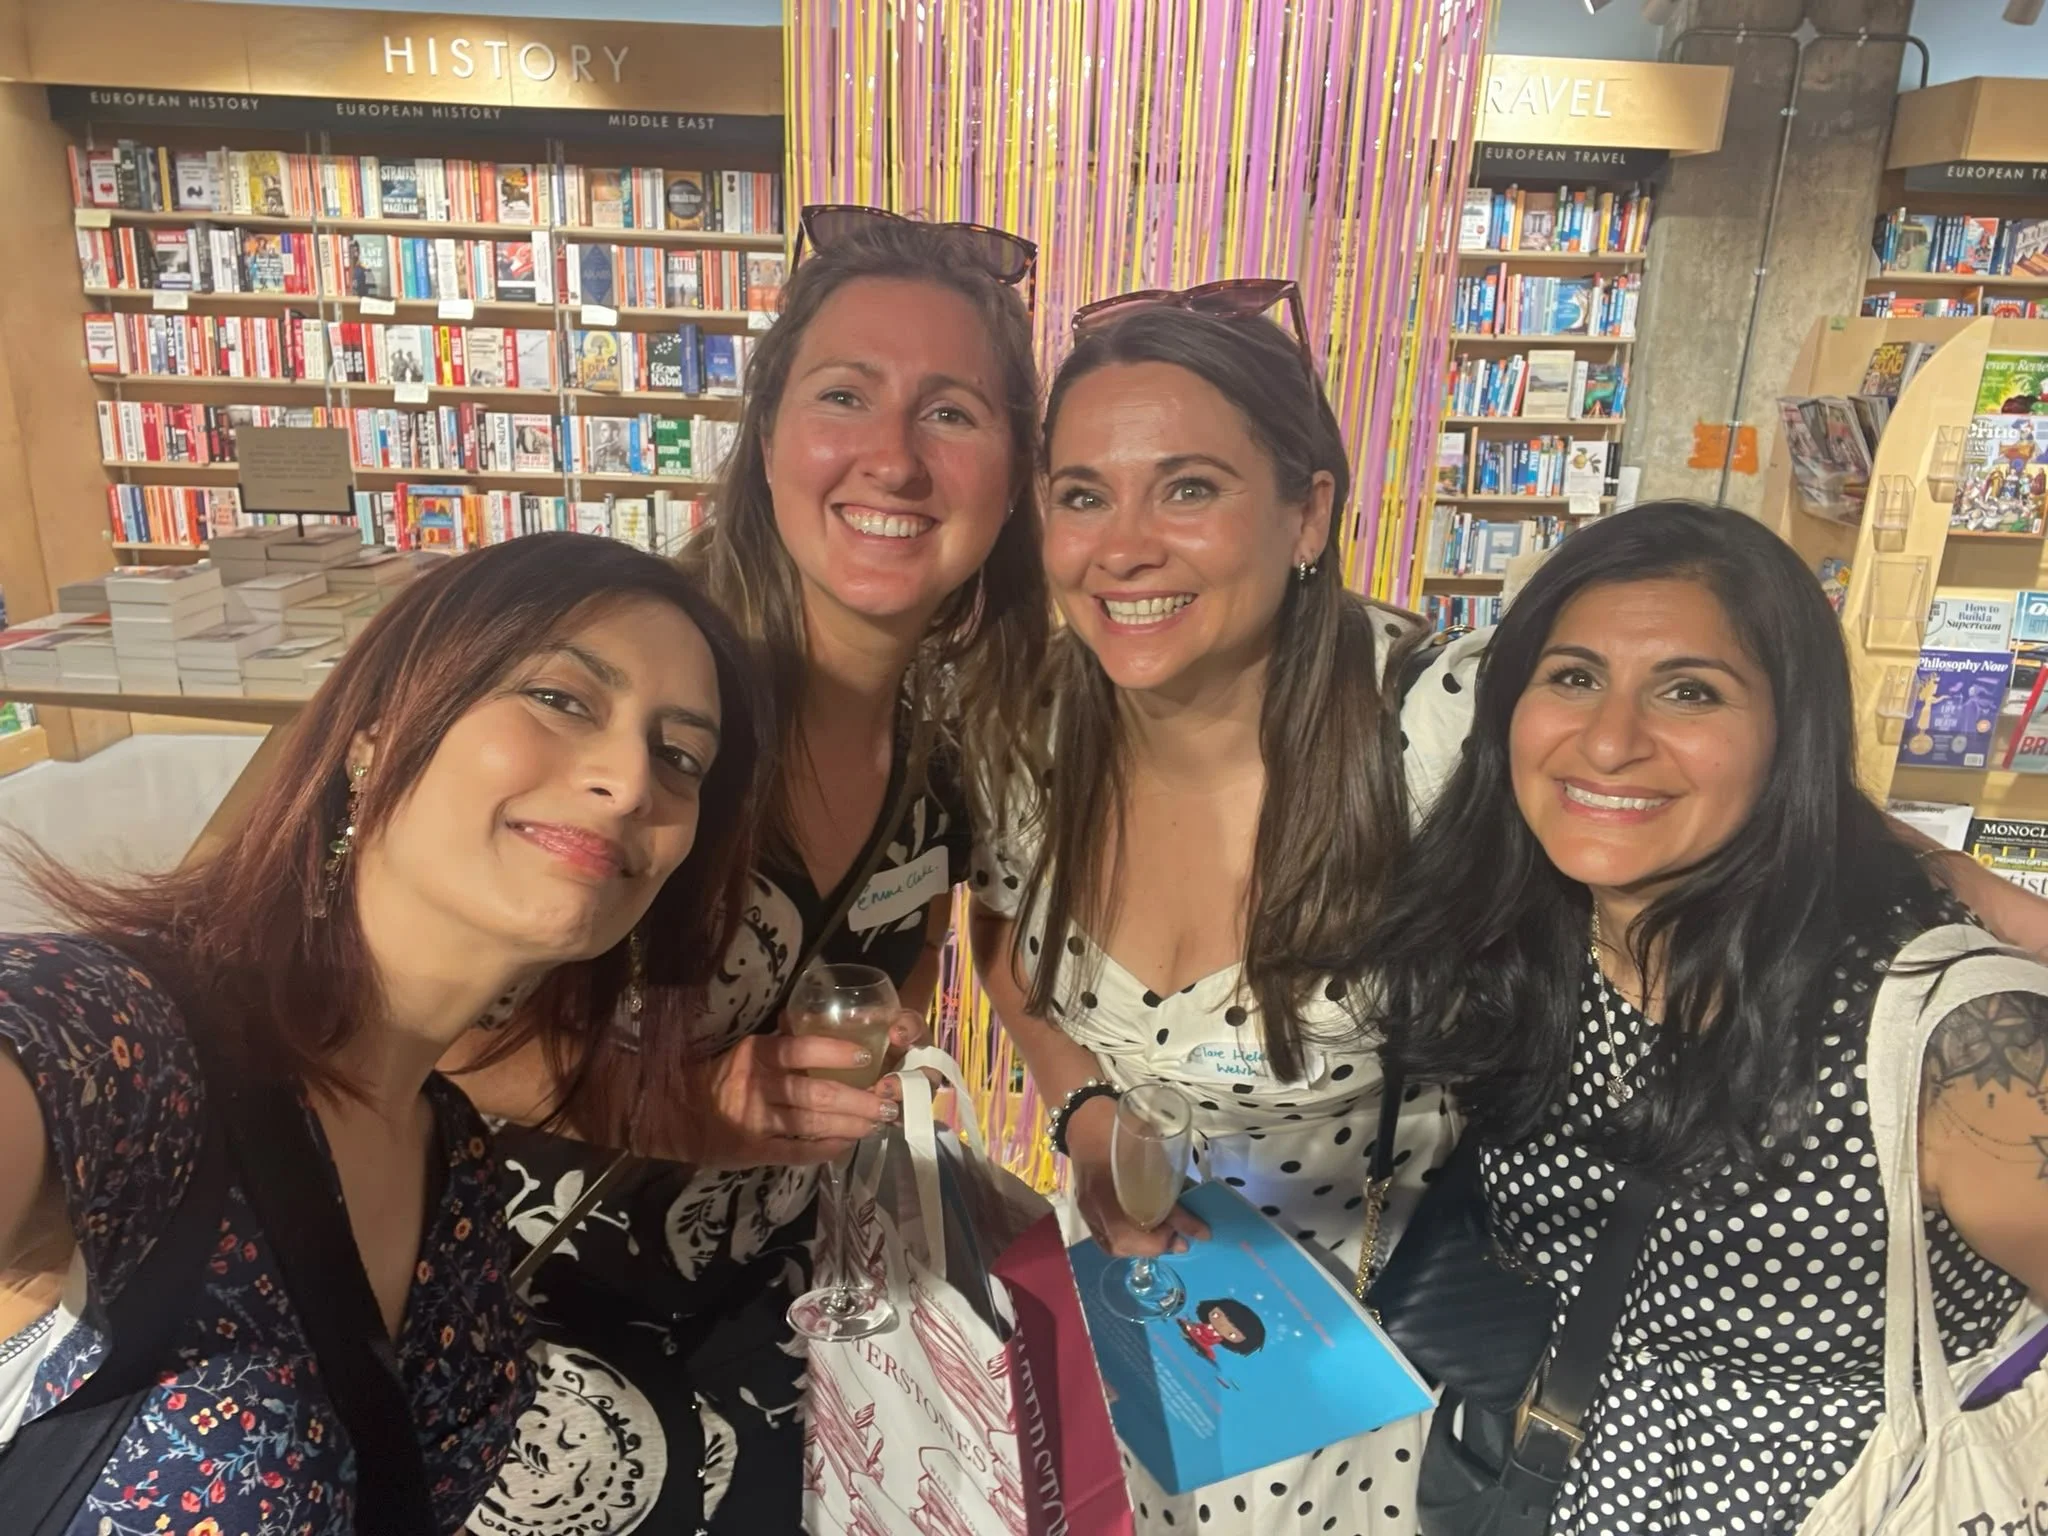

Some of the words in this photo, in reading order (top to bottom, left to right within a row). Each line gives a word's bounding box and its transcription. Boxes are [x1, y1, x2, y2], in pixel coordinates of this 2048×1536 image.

[384, 36, 630, 83] HISTORY
[90, 91, 180, 107] EUROPEAN
[189, 96, 260, 111] HISTORY
[1484, 74, 1612, 118] RAVEL
[336, 103, 424, 118] EUROPEAN
[432, 106, 503, 120] HISTORY
[608, 115, 670, 129] MIDDLE
[677, 117, 715, 130] EAST
[1484, 147, 1567, 161] EUROPEAN
[1574, 151, 1627, 165] TRAVEL
[381, 165, 416, 181] STRAITS
[1946, 165, 2024, 179] EUROPEAN
[496, 416, 504, 445] PUTIN
[1965, 602, 1987, 612] How
[1989, 605, 2000, 613] to
[1946, 619, 2002, 631] Superteam
[1958, 612, 1985, 622] Build
[1920, 657, 1981, 673] Philosophy
[1980, 661, 2009, 673] Now
[1191, 1046, 1226, 1060] Clare
[850, 1337, 987, 1474] TERSTONES
